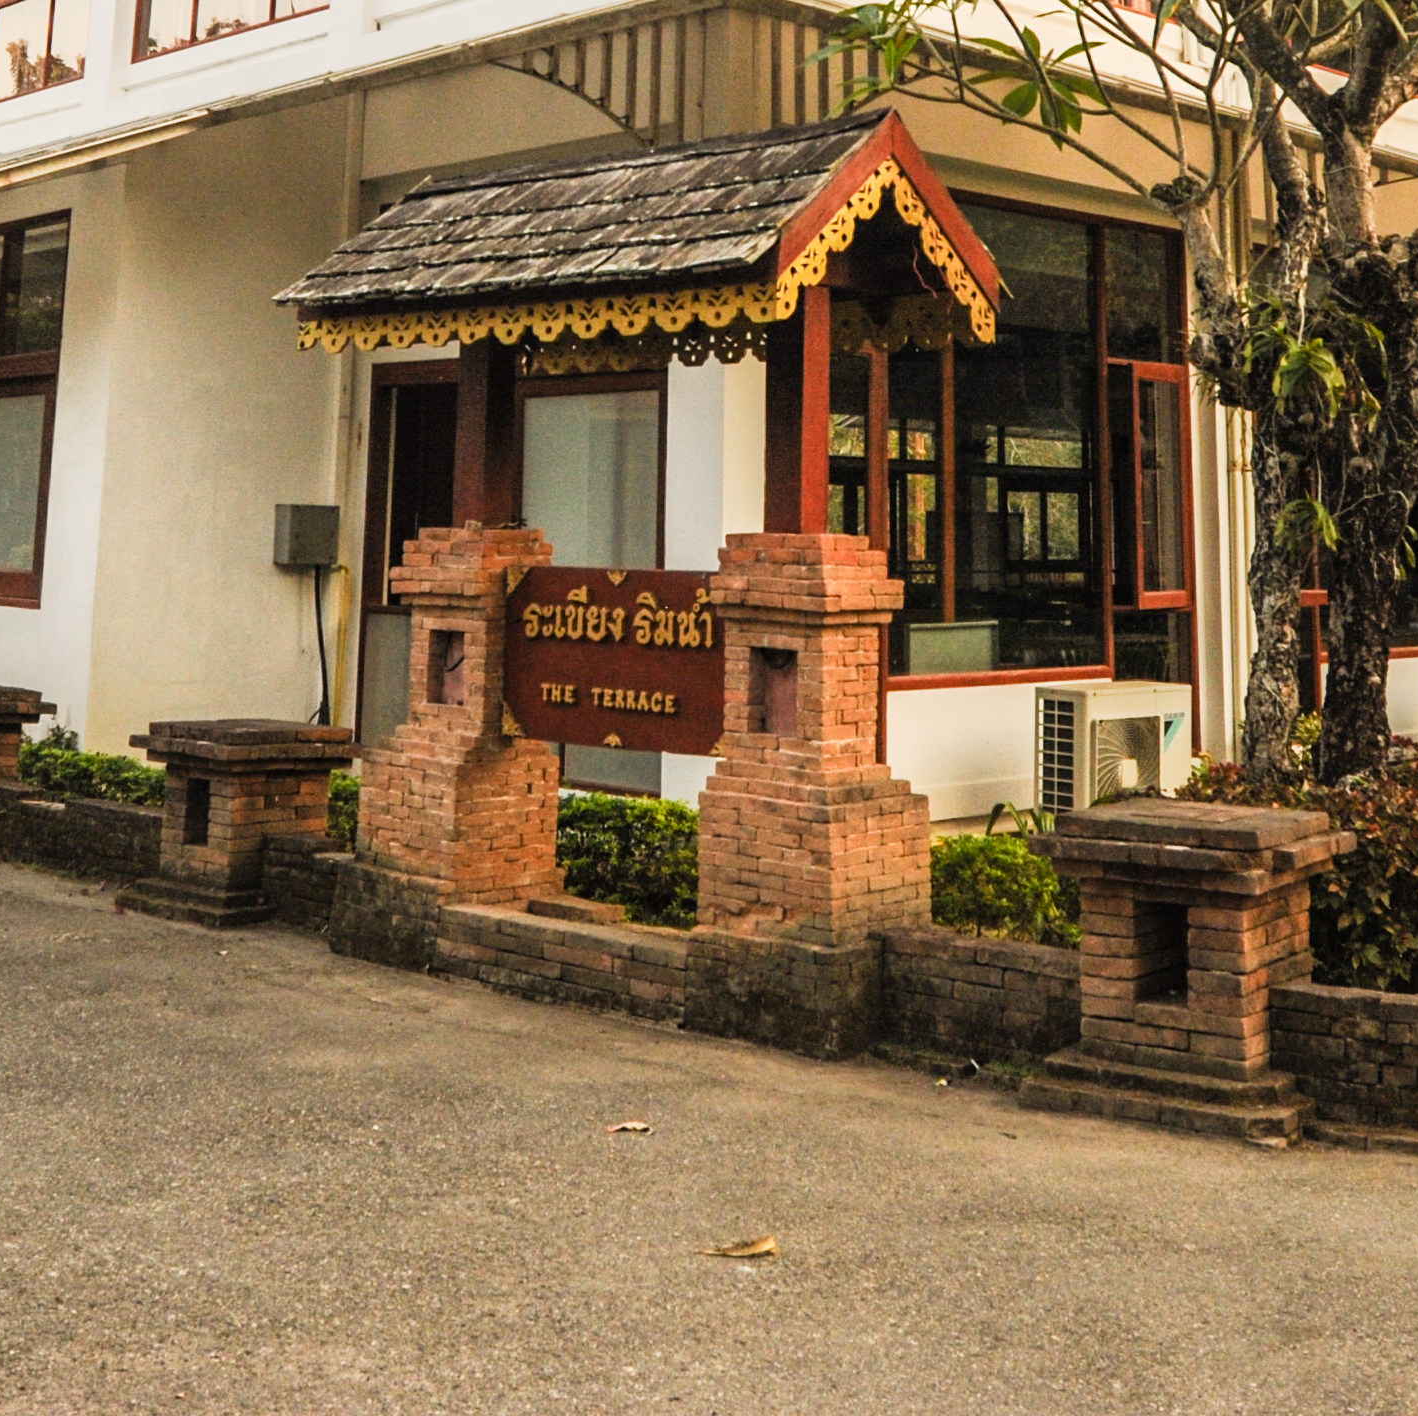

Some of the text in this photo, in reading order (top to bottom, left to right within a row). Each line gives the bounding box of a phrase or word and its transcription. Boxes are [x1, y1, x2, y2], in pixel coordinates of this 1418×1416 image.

[522, 585, 626, 642] ระเบียง
[541, 683, 677, 715] THE TERRACE
